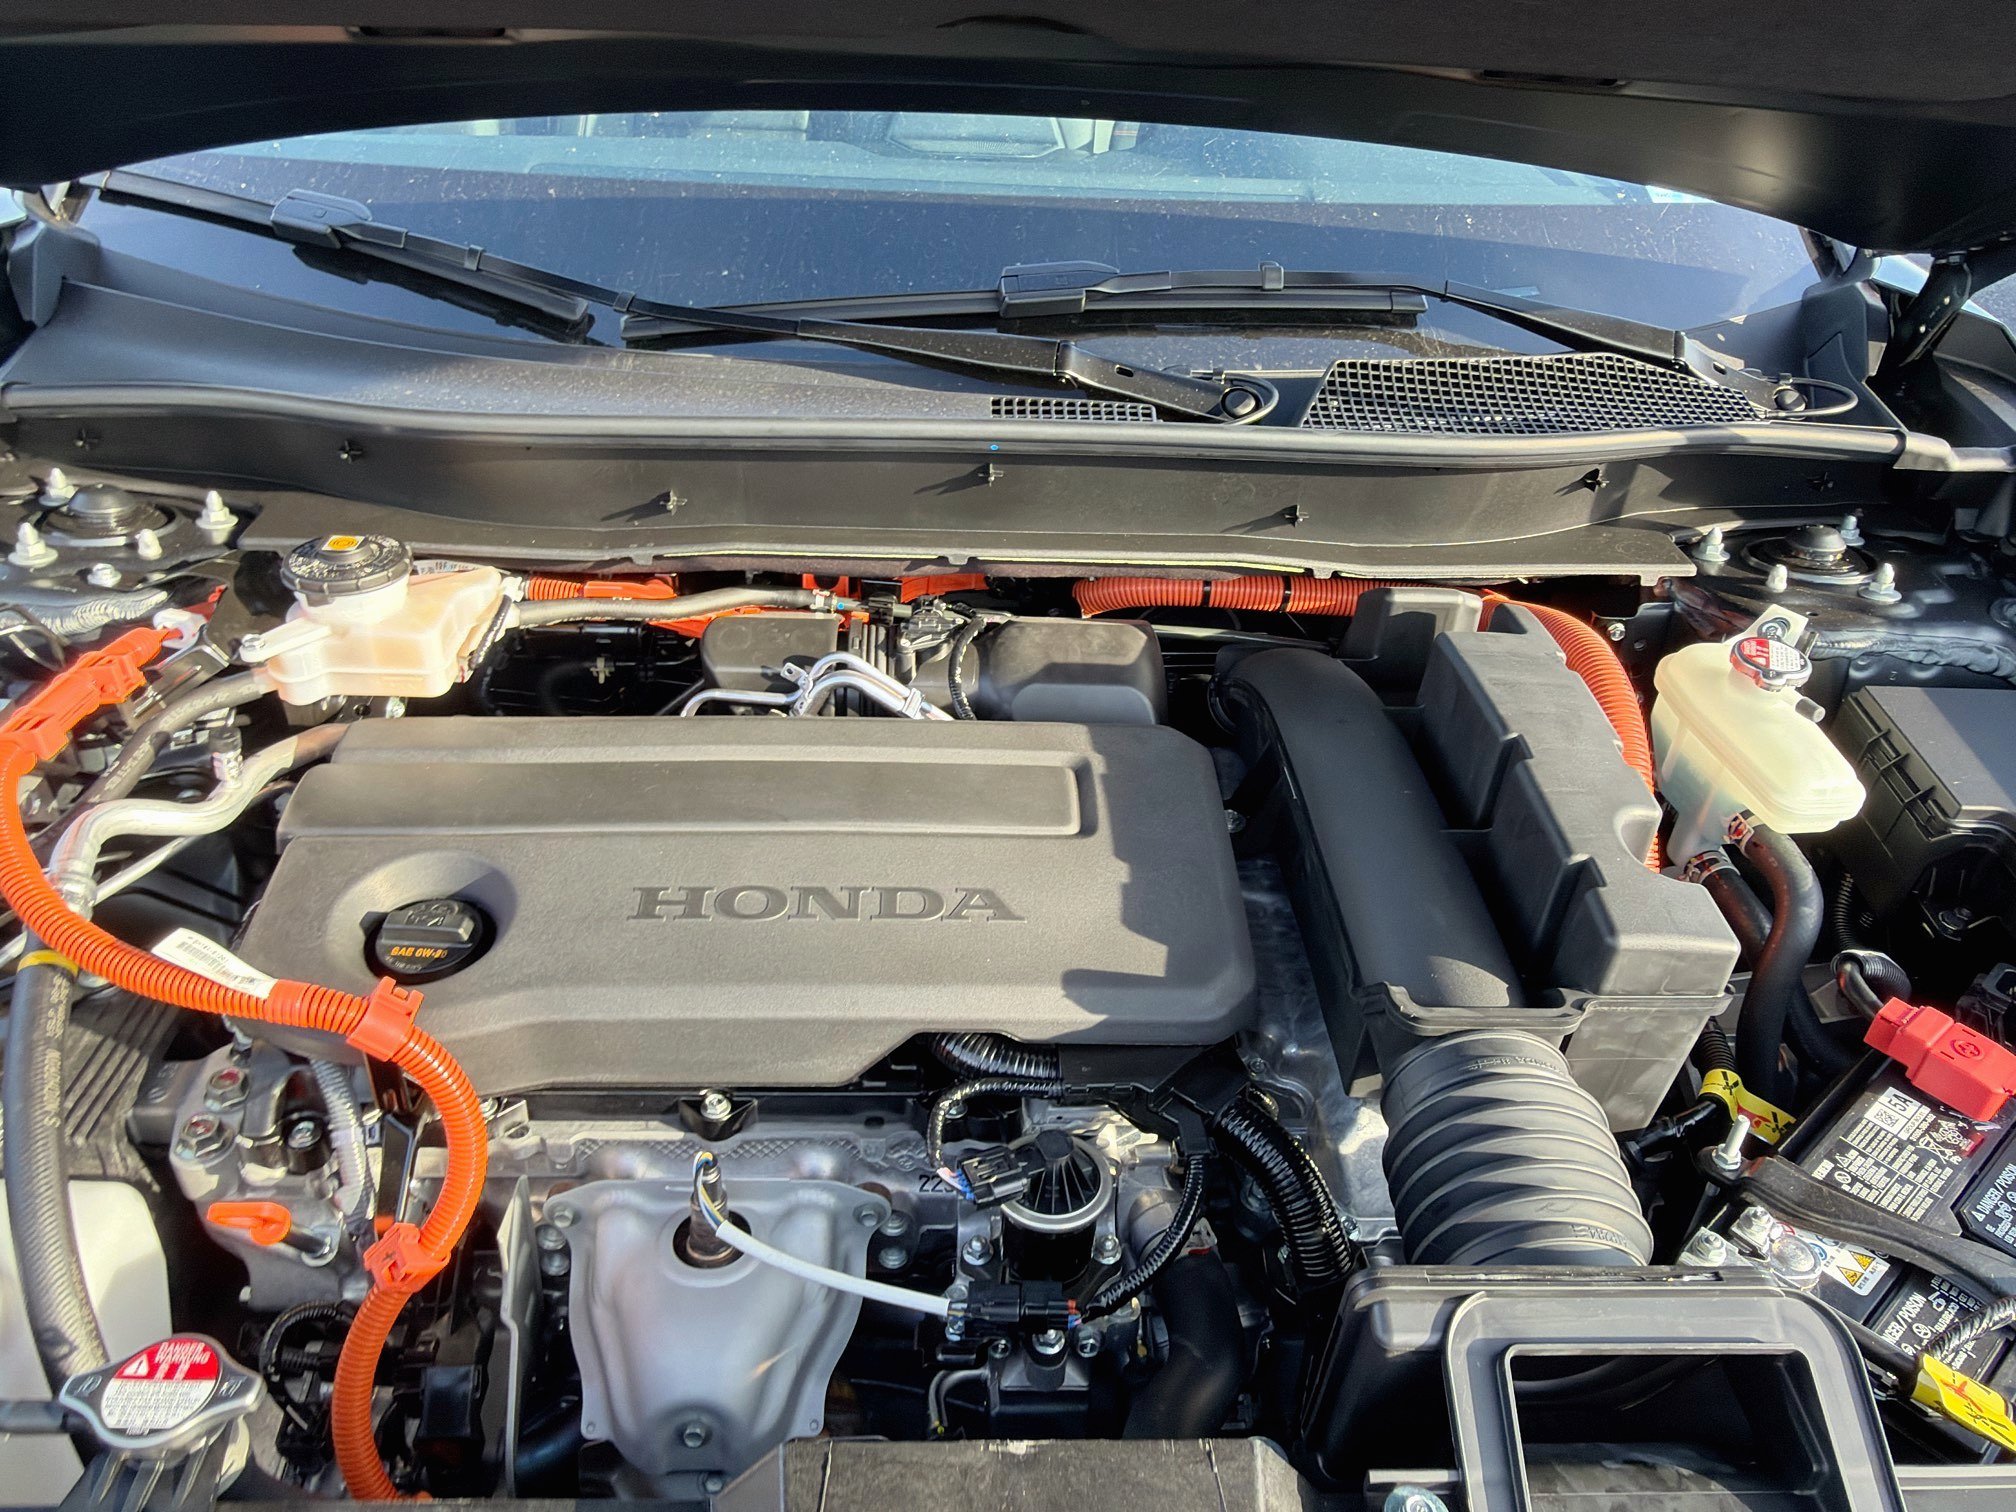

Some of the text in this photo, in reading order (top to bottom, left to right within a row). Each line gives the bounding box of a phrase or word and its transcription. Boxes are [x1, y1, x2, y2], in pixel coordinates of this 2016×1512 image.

[626, 884, 1027, 923] HONDA
[1888, 1092, 1914, 1113] 5A
[918, 1173, 955, 1193] 22
